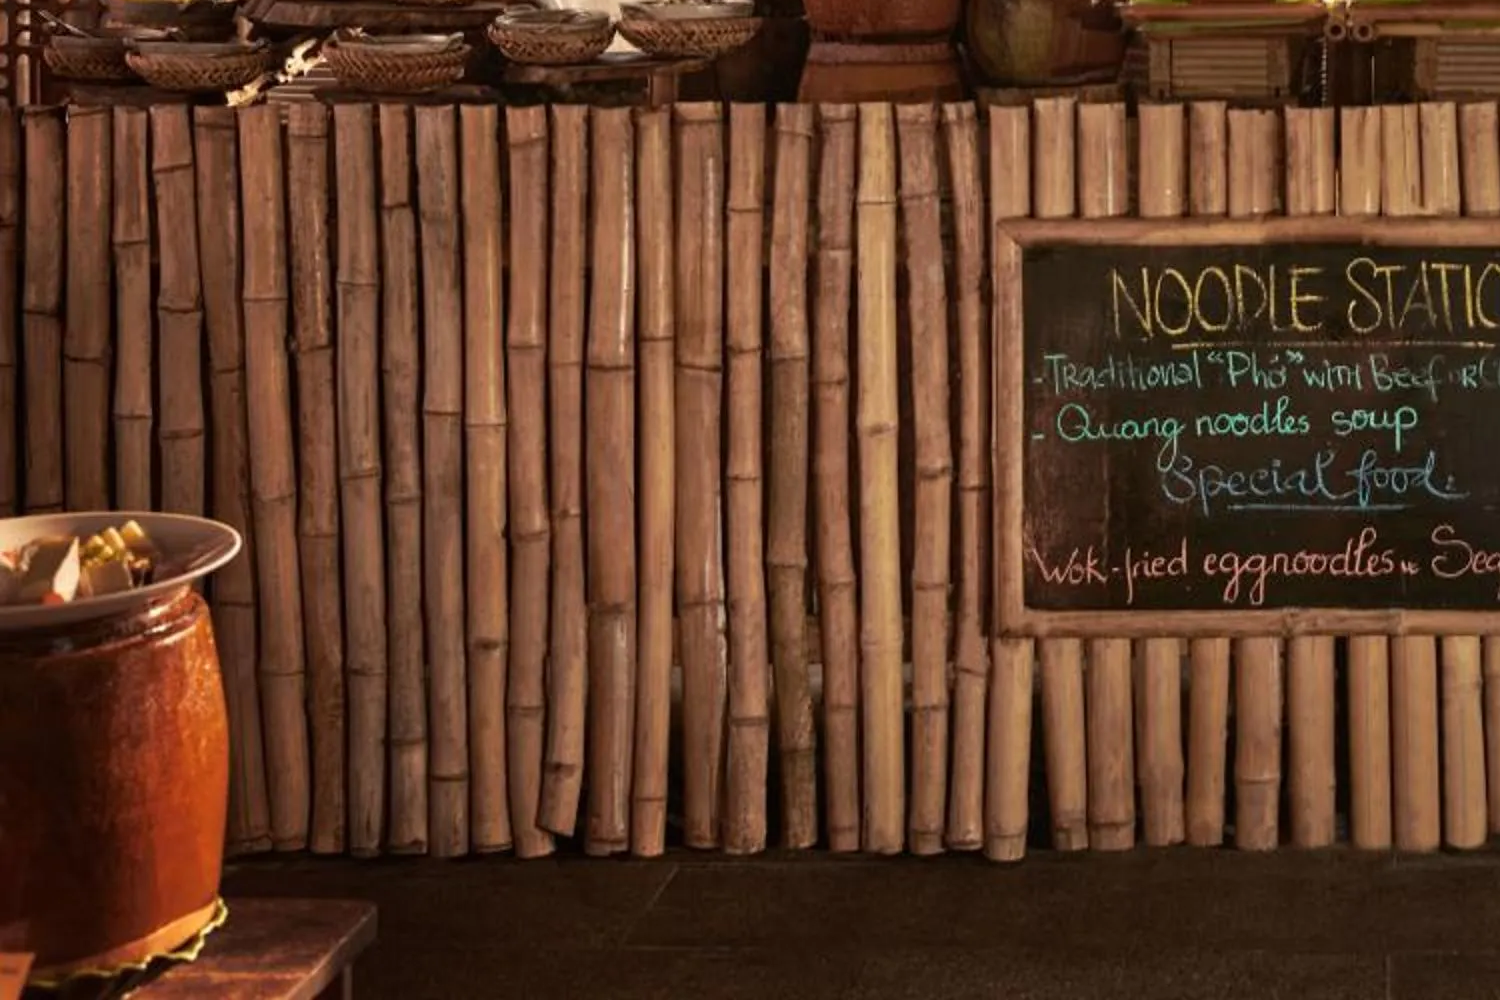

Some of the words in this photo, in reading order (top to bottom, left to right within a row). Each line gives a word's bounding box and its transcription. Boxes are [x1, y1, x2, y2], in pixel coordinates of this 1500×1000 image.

[1110, 264, 1328, 341] NOODLE
[1369, 352, 1445, 402] Beef
[1057, 403, 1186, 472] Quang
[1196, 396, 1310, 436] noodles
[1331, 406, 1418, 452] soup
[1162, 450, 1336, 518] Special
